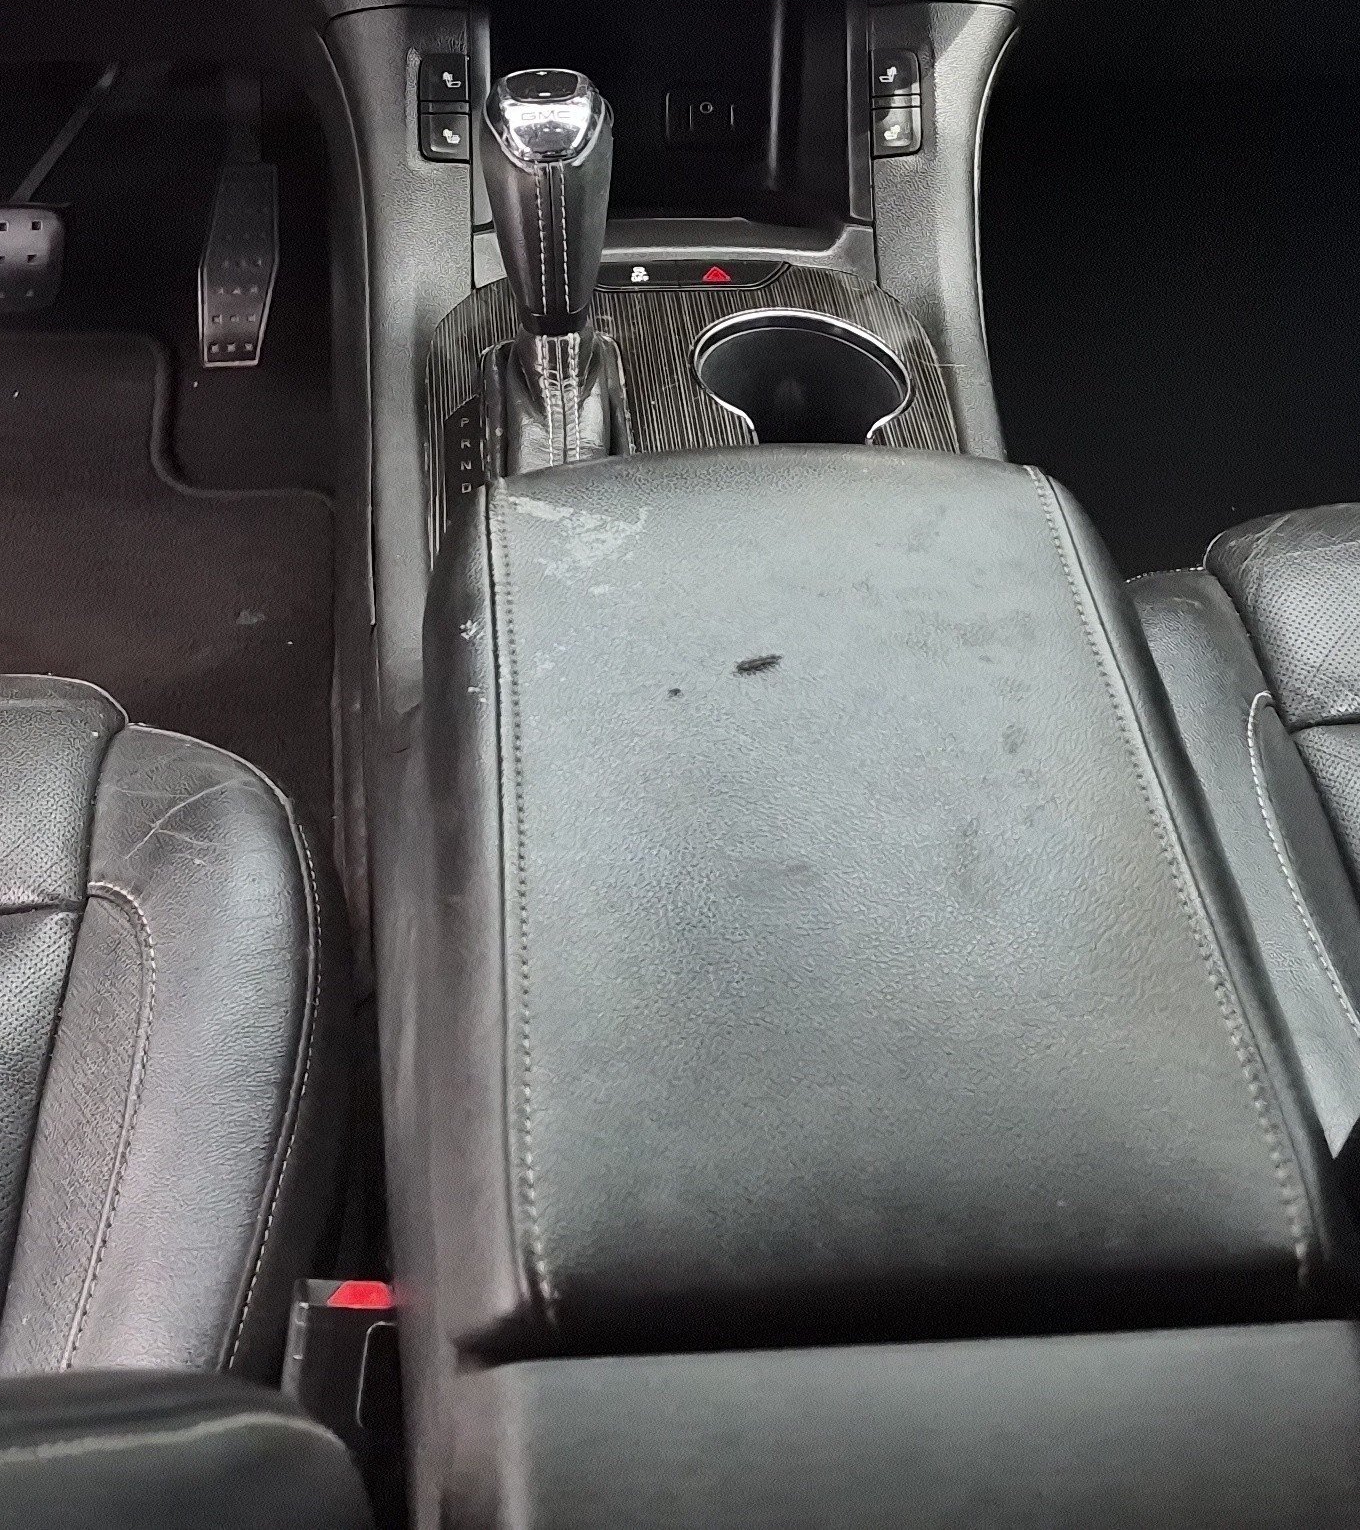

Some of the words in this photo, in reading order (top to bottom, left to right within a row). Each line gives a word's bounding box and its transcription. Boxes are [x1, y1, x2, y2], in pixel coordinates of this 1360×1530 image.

[522, 111, 570, 120] GMC
[460, 418, 469, 427] P
[461, 439, 471, 449] R
[461, 460, 472, 470] N
[461, 483, 472, 494] D
